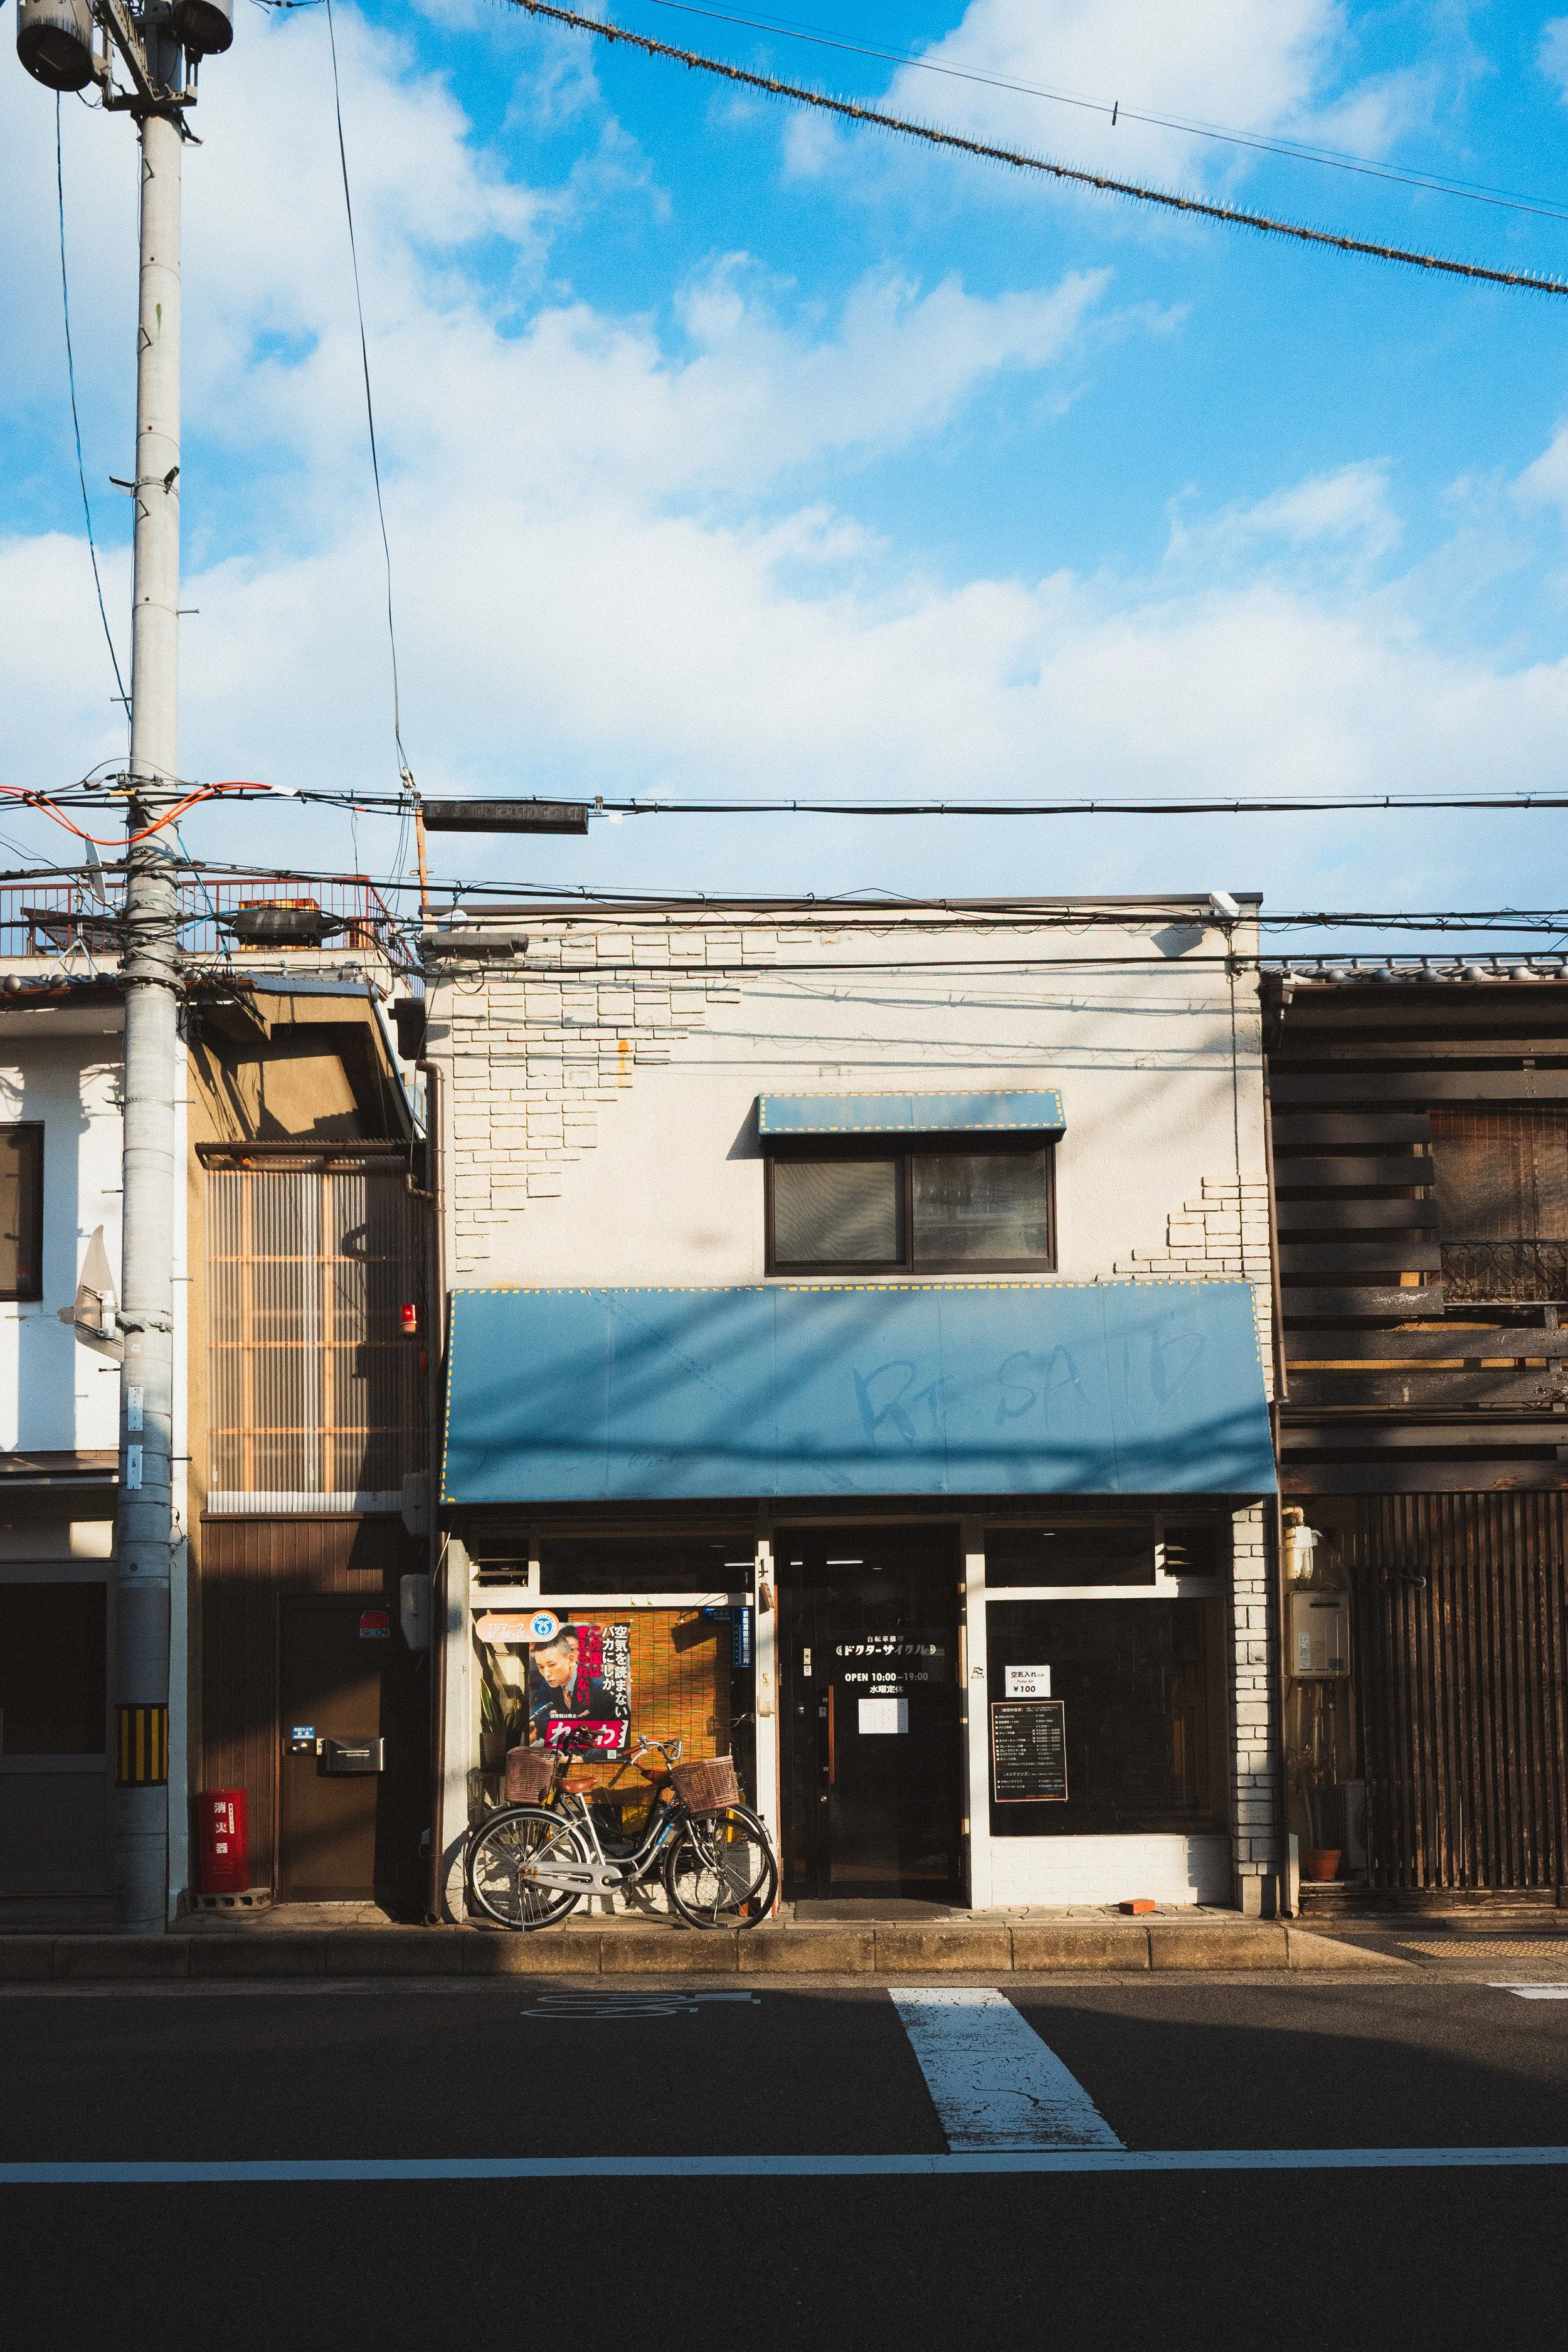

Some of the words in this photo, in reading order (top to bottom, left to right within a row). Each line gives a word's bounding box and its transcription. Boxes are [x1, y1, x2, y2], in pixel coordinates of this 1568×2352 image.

[487, 1623, 524, 1631] TSマーク
[589, 1626, 602, 1678] この国は
[845, 1645, 927, 1656] ドクターサイクル
[576, 1626, 591, 1705] 変えられない。
[601, 1626, 615, 1695] バカにしか、
[615, 1626, 628, 1717] 空気を読まない
[845, 1673, 869, 1682] OPEN
[869, 1685, 904, 1693] 水曜定休
[214, 1802, 228, 1853] 消火器
